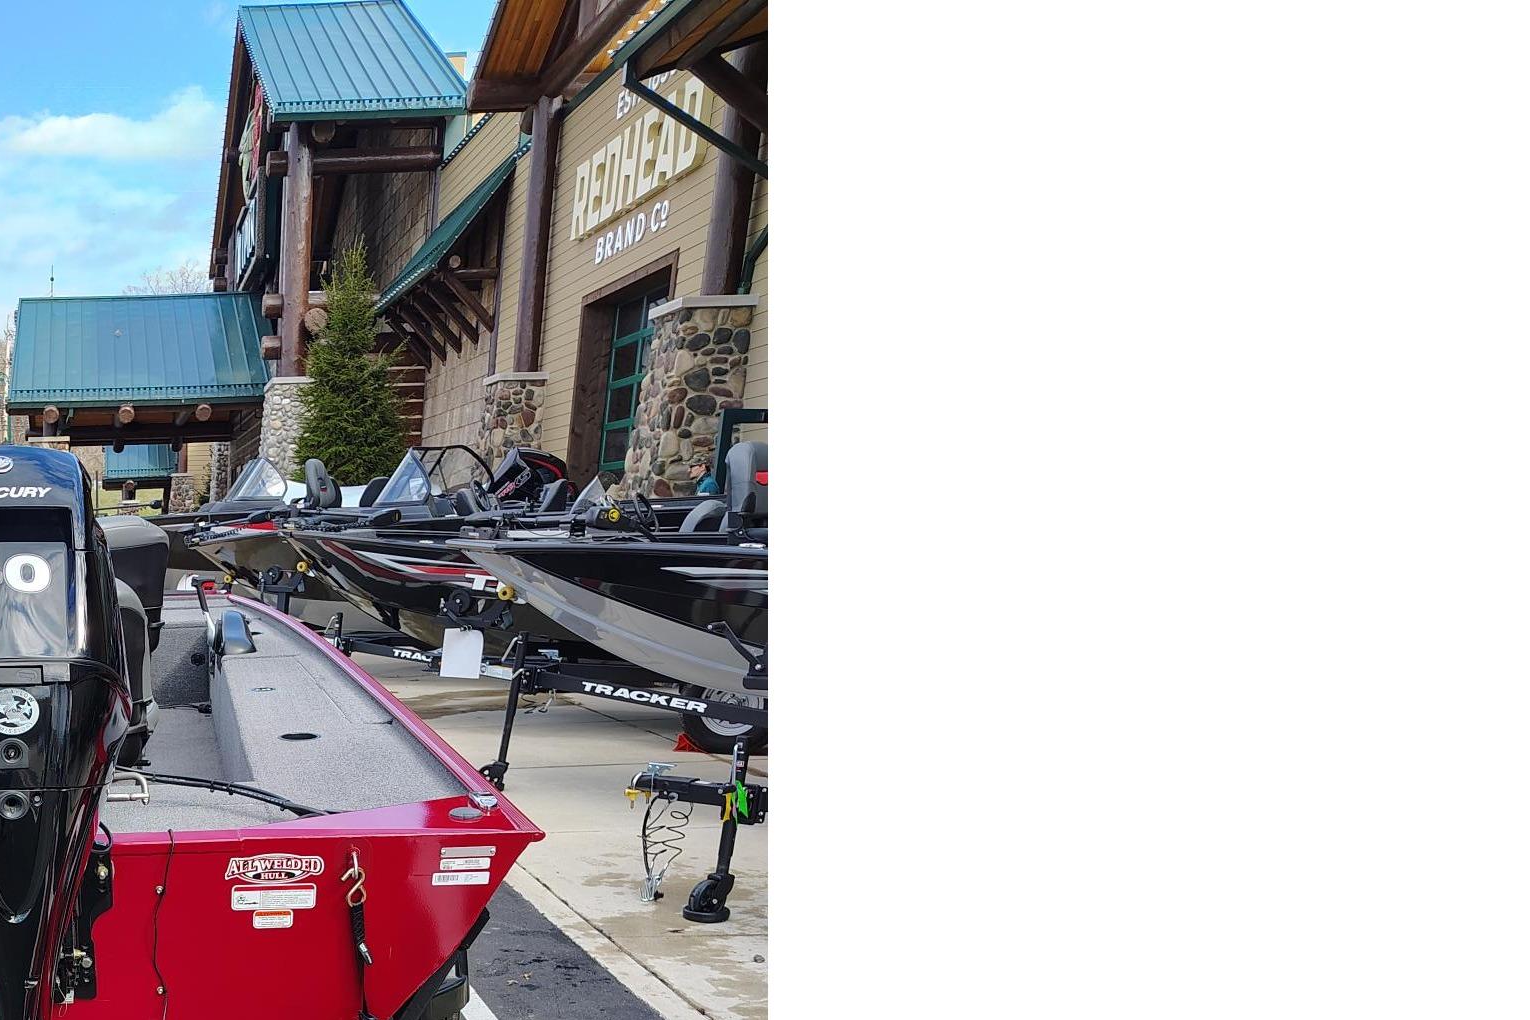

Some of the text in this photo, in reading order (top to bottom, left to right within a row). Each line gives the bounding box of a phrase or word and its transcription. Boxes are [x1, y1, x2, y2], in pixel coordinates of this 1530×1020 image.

[570, 76, 707, 241] REDHEAD
[594, 212, 646, 265] BRAND
[581, 681, 708, 714] TRACKER
[227, 857, 322, 878] ALL WELDED
[260, 871, 288, 880] HULL
